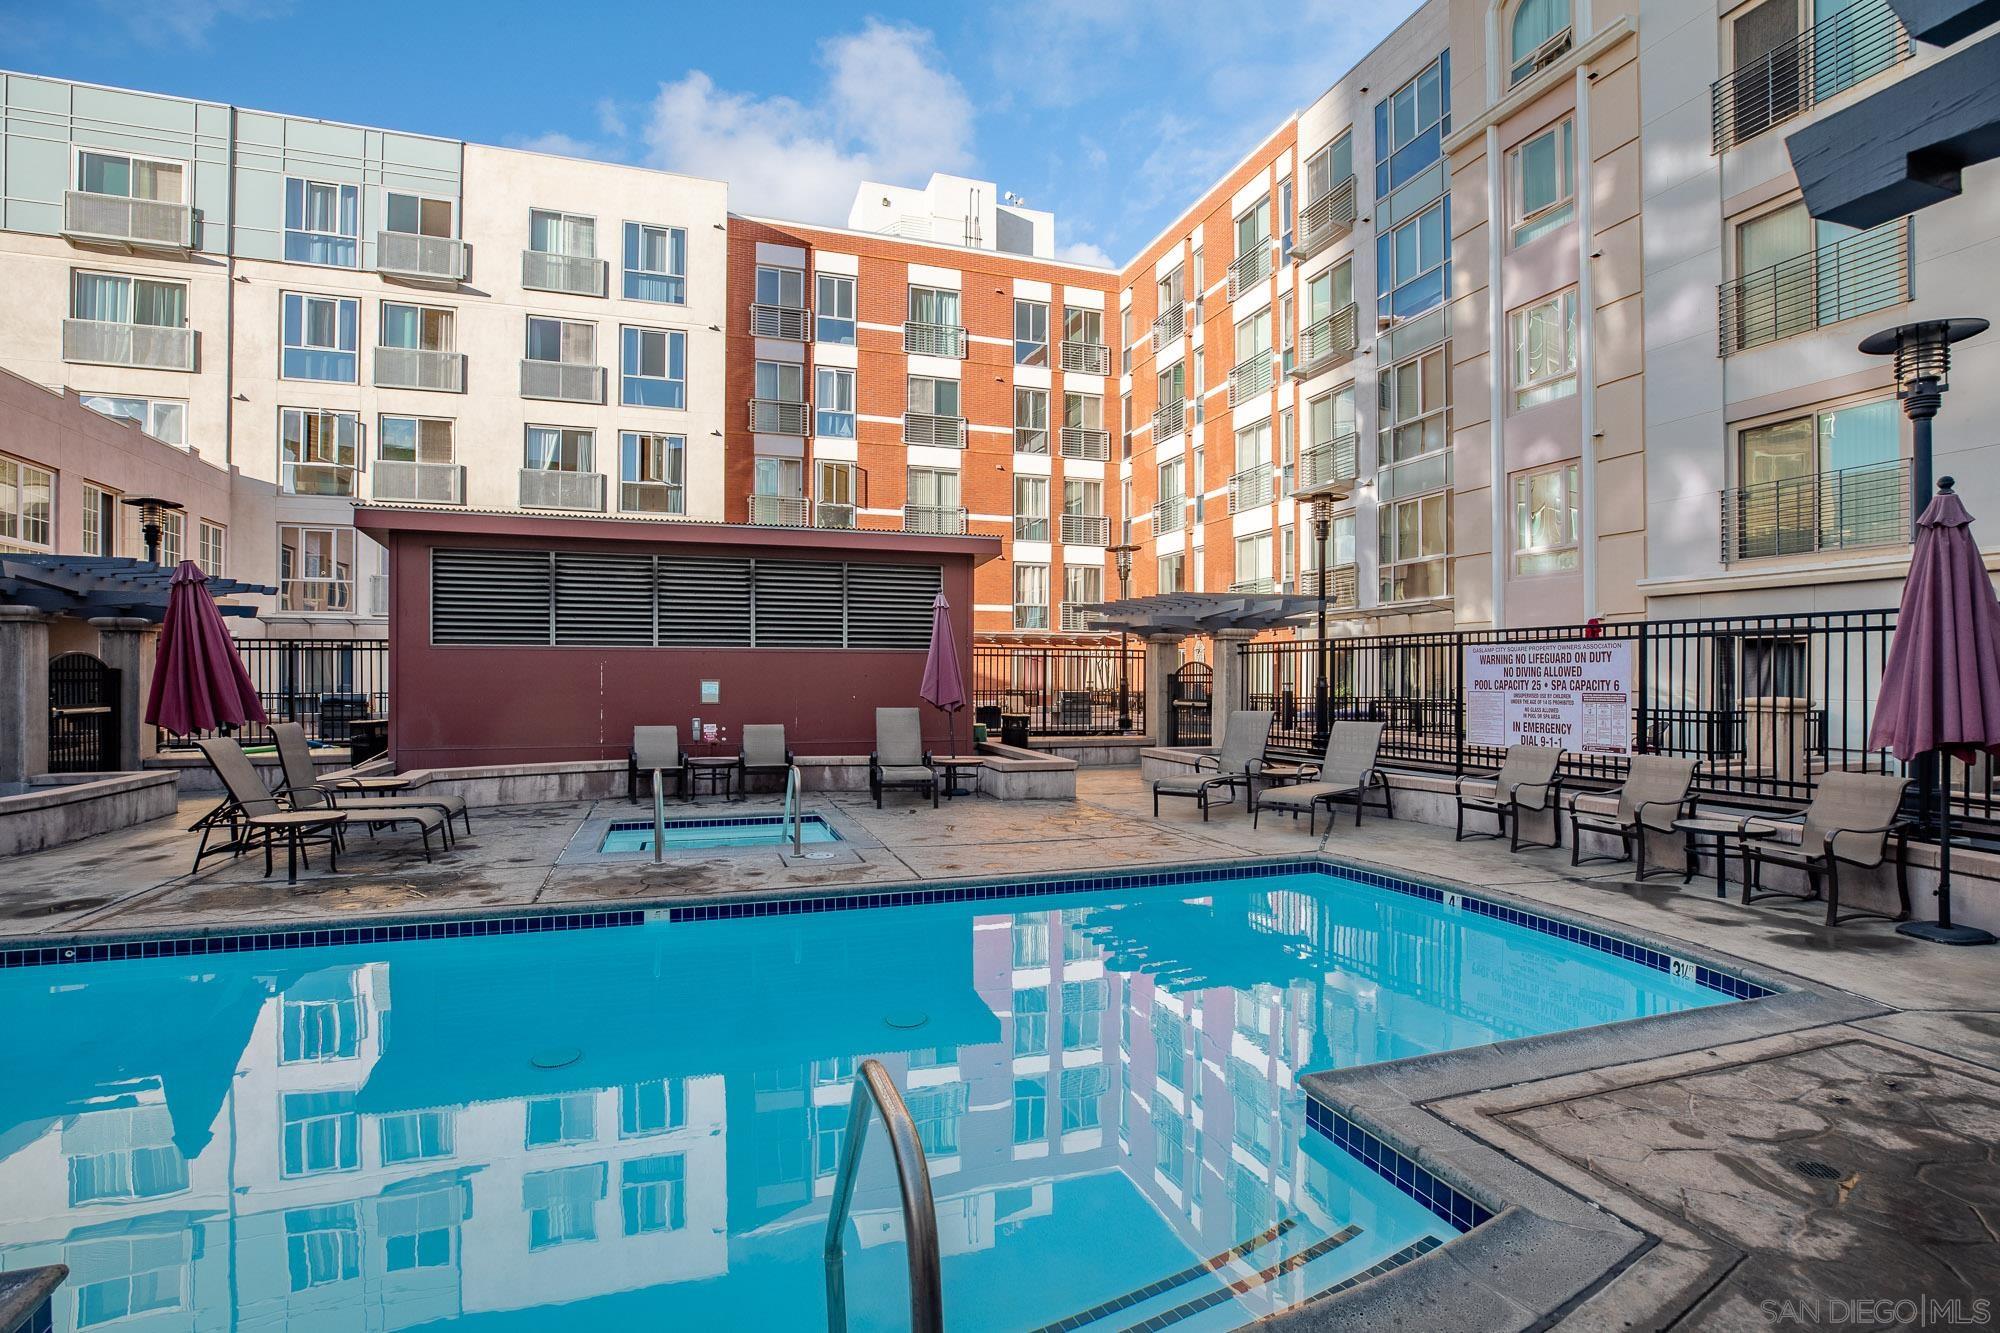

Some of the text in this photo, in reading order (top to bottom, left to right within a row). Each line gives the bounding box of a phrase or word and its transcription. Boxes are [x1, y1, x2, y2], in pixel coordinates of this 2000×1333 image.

[1479, 651, 1612, 664] WARNING NO LIFEGUARD ON DUTY
[1504, 666, 1582, 677] NO DIVING ALLOWED
[1474, 680, 1620, 691] POOL CAPACITY 25 SPA CAPACITY 6
[1512, 722, 1572, 735] IN EMERGENCY
[1521, 735, 1562, 748] DIAL 9-1-1
[1448, 895, 1455, 907] 4
